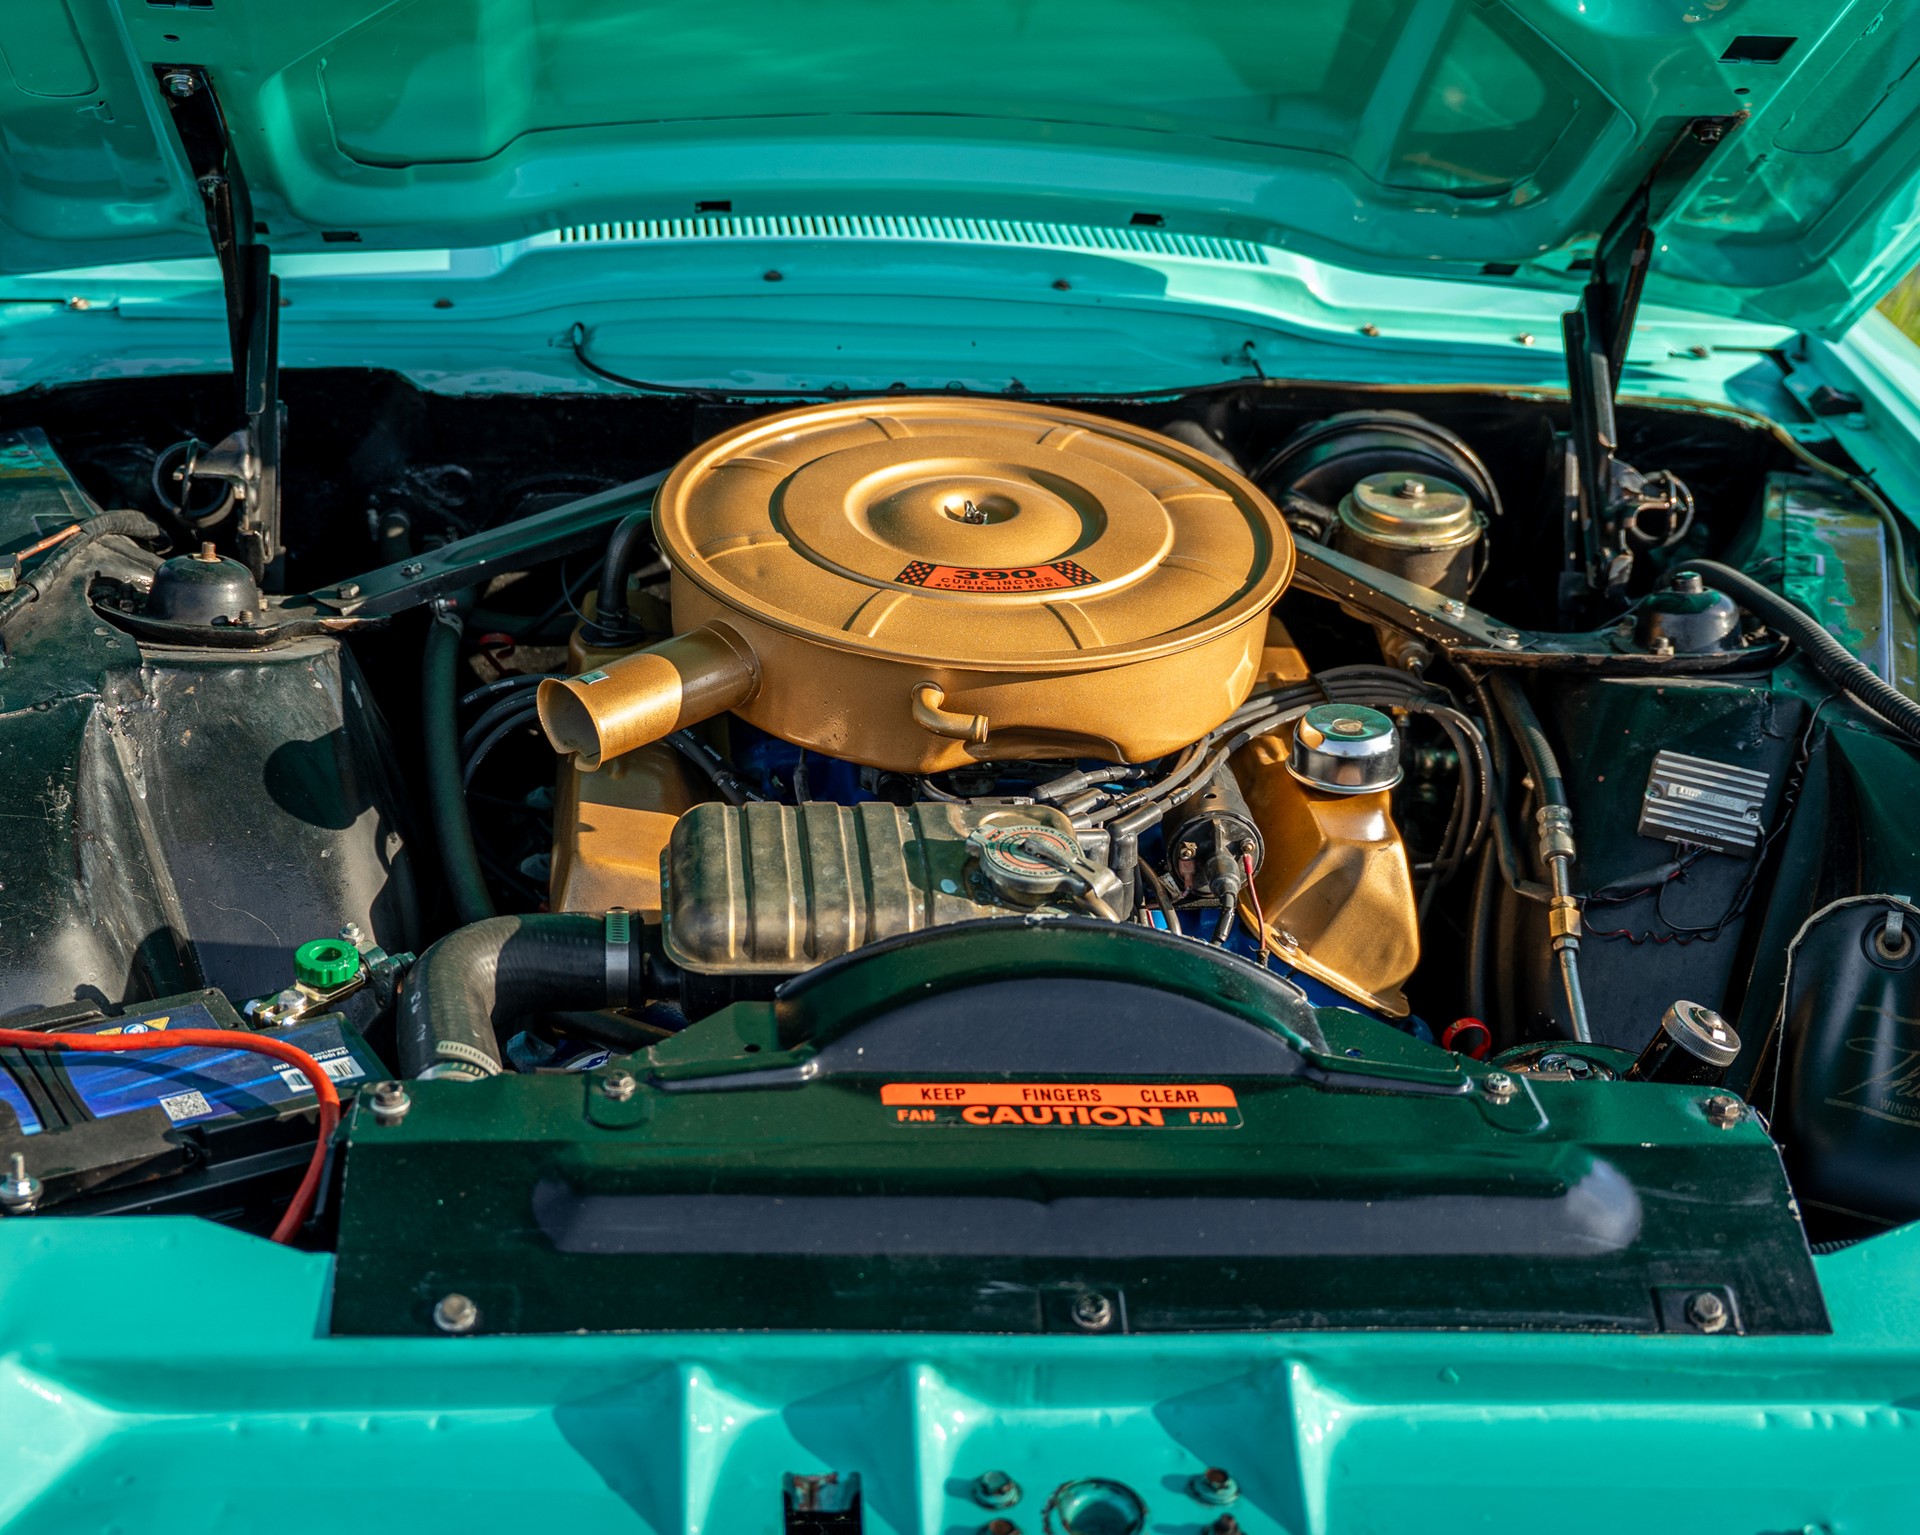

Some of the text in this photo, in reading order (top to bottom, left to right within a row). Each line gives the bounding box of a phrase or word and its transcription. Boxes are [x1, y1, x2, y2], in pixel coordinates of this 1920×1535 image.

[954, 570, 1037, 580] 390
[941, 576, 1053, 586] CUBIC INCHES
[1029, 581, 1062, 590] FUEL
[921, 1088, 1199, 1103] KEEP FINGERS CLEAR
[897, 1105, 1227, 1127] FAN CAUTION FAN
